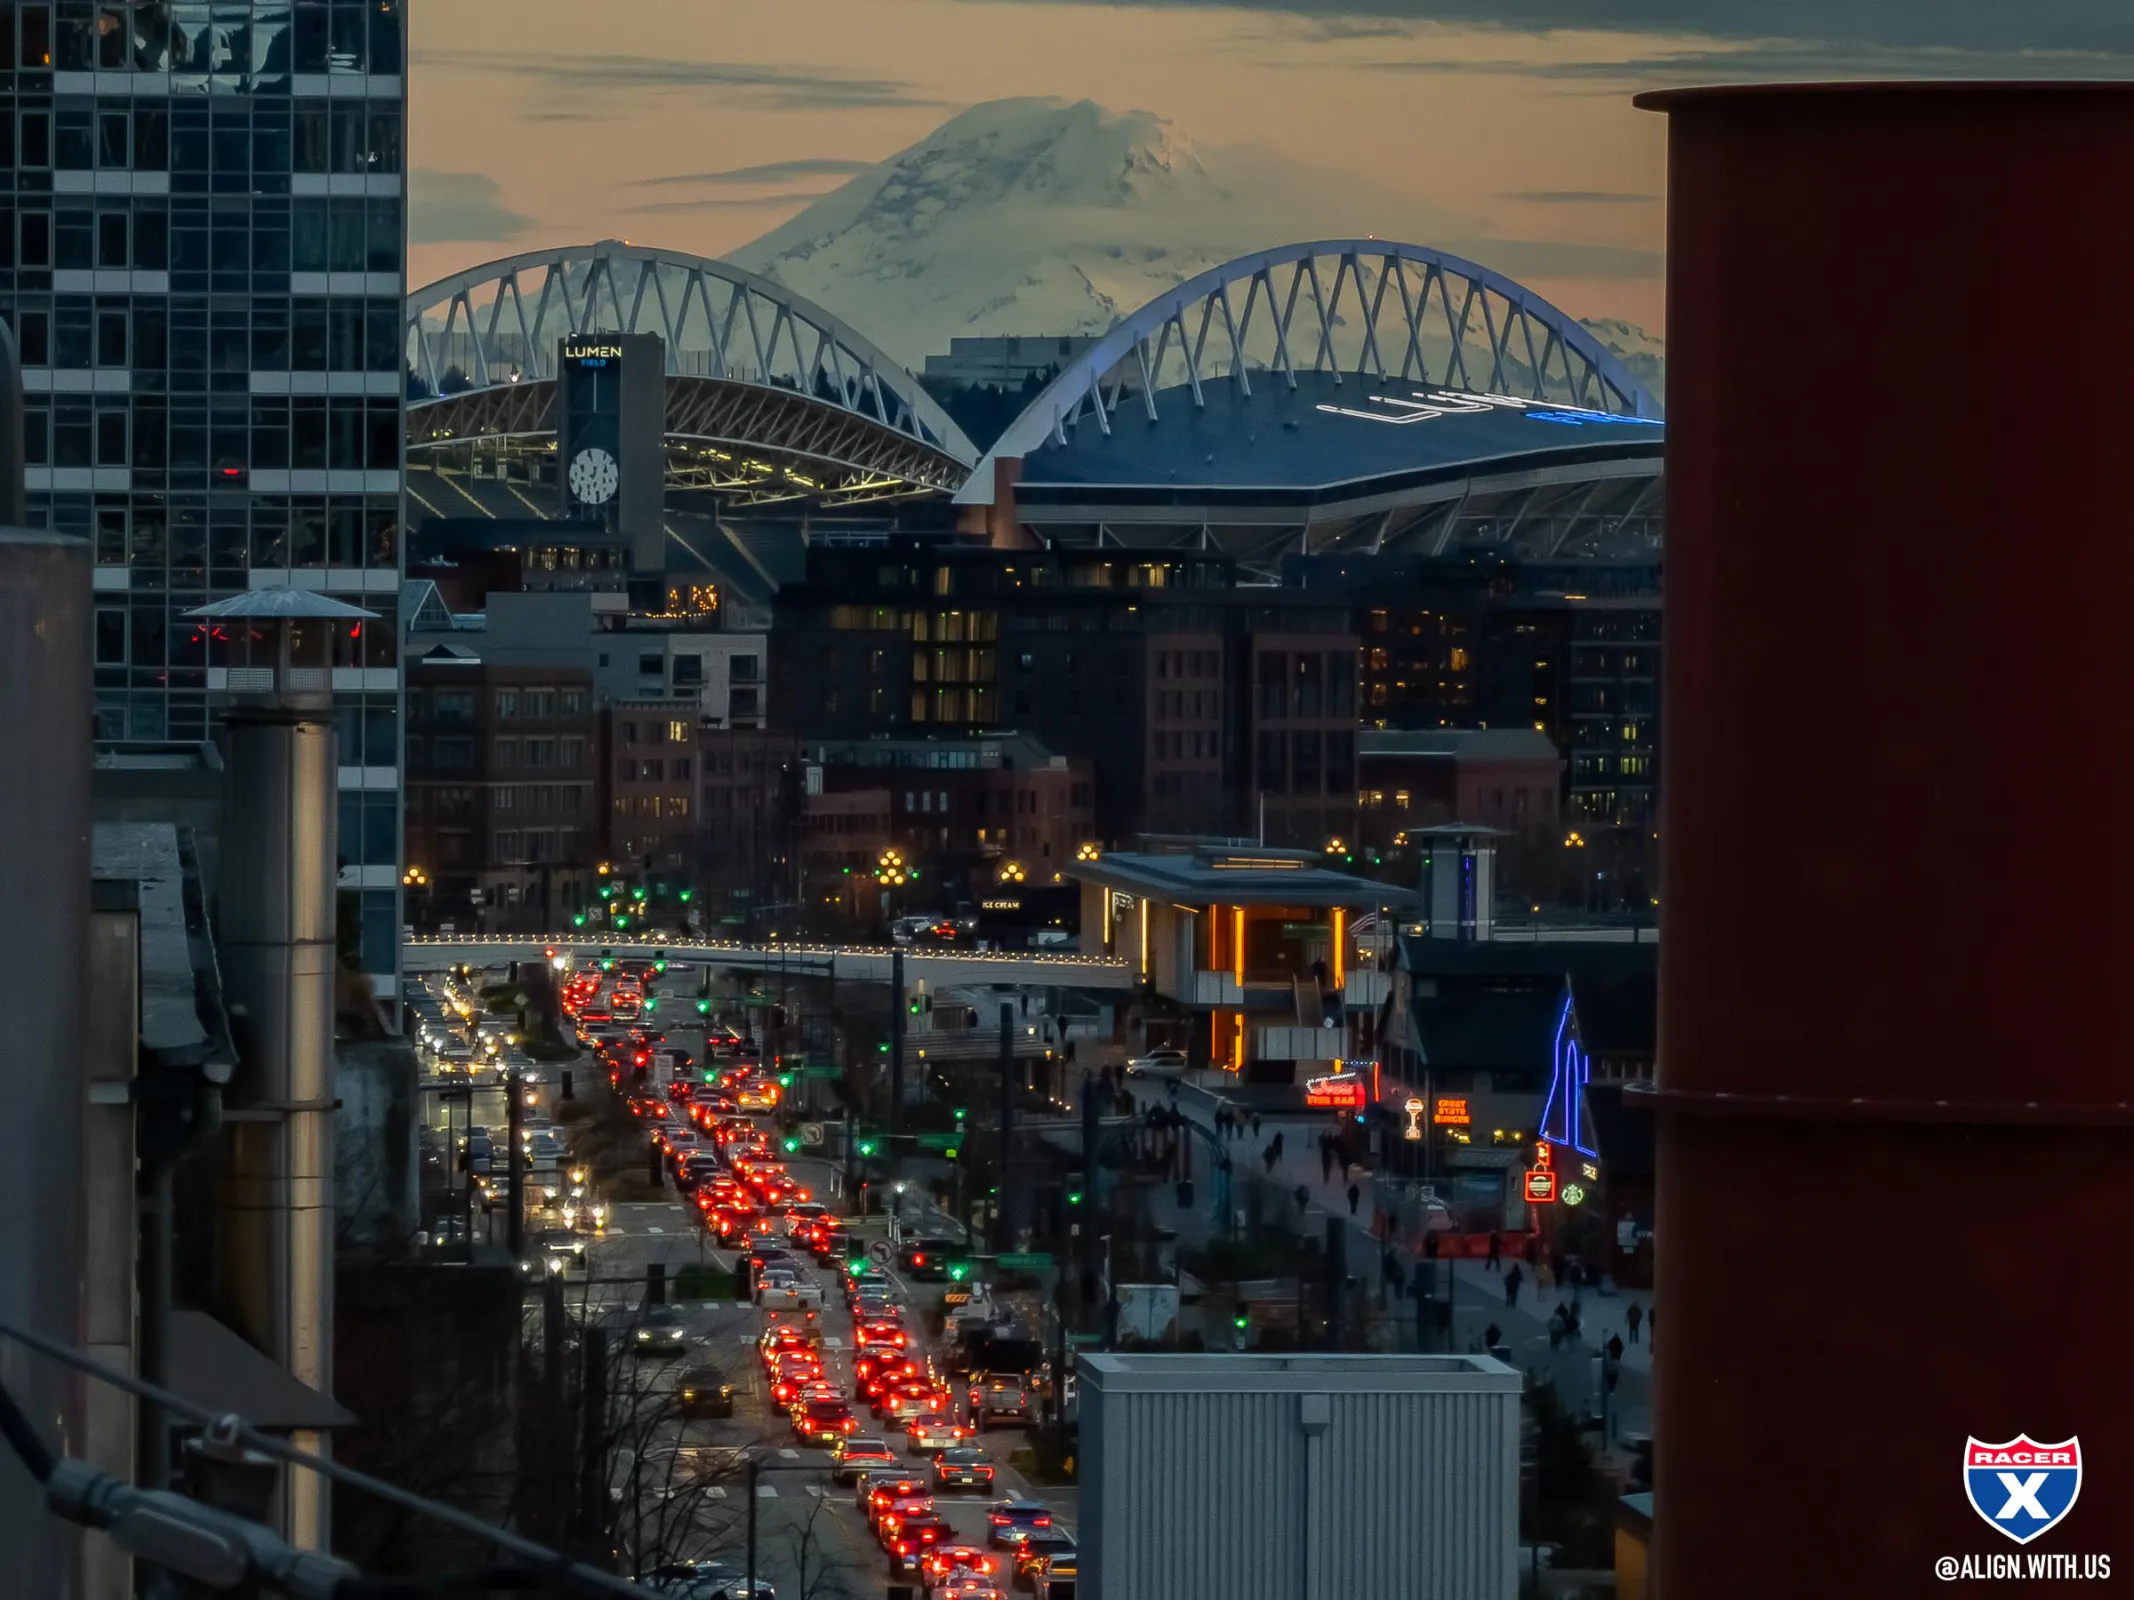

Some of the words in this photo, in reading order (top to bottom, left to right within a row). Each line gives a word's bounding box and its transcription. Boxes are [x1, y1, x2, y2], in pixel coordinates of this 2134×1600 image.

[565, 346, 622, 358] LUMEN
[580, 359, 607, 367] FIELD
[982, 901, 993, 909] ICE
[994, 901, 1020, 909] CREAM
